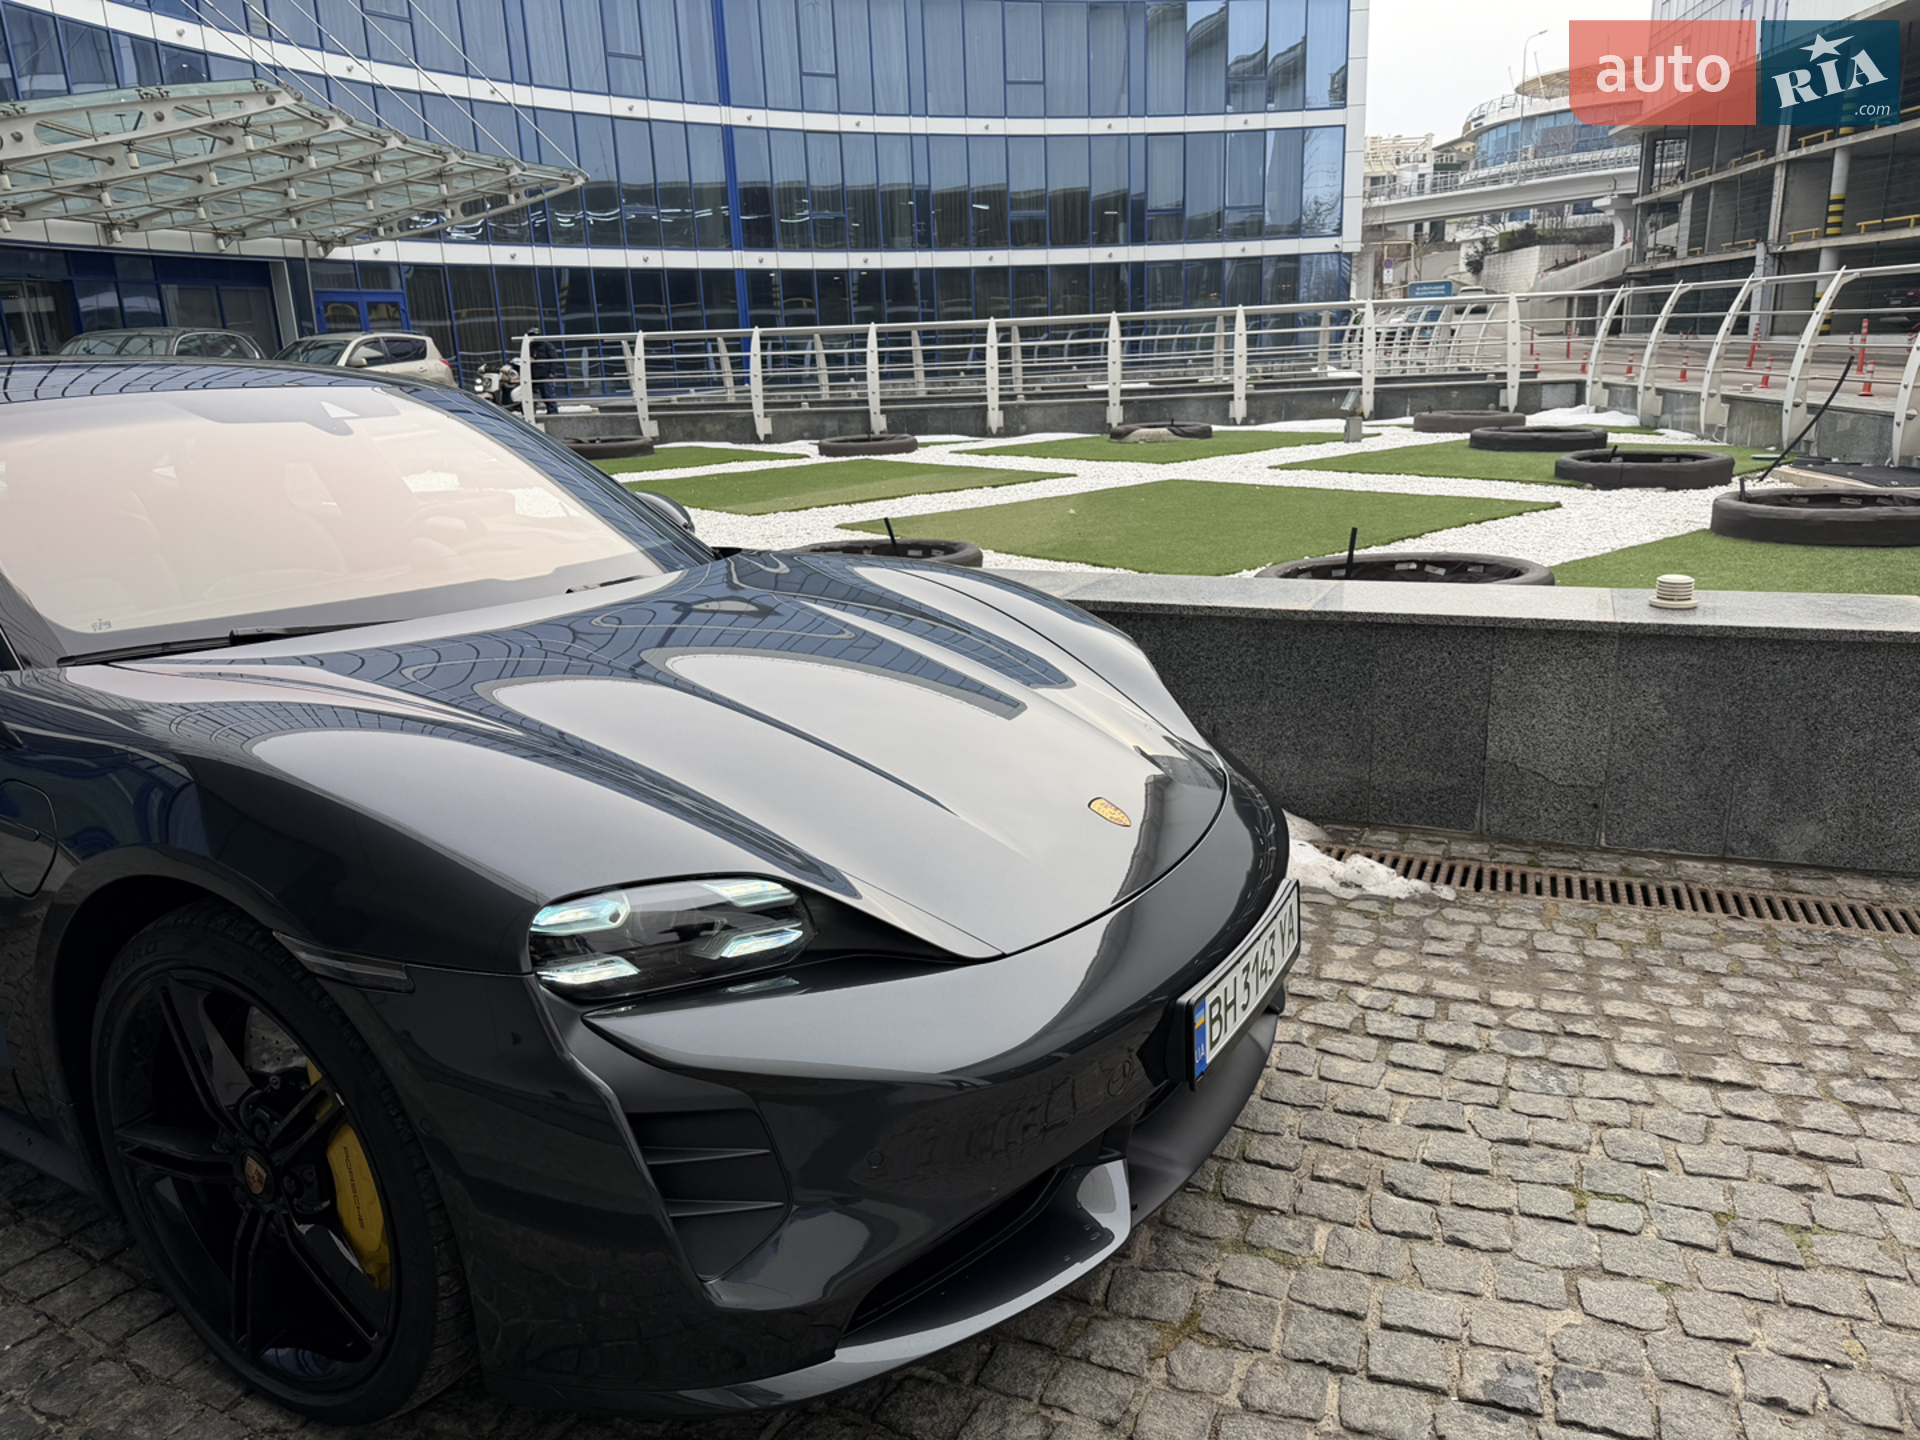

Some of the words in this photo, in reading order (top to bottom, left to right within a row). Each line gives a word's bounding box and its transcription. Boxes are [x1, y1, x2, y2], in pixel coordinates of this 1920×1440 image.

[1208, 975, 1237, 1051] BH
[1241, 928, 1276, 1011] 3143
[1279, 903, 1295, 958] YA
[1194, 1043, 1206, 1064] UA
[343, 1146, 365, 1230] PORSCHE
